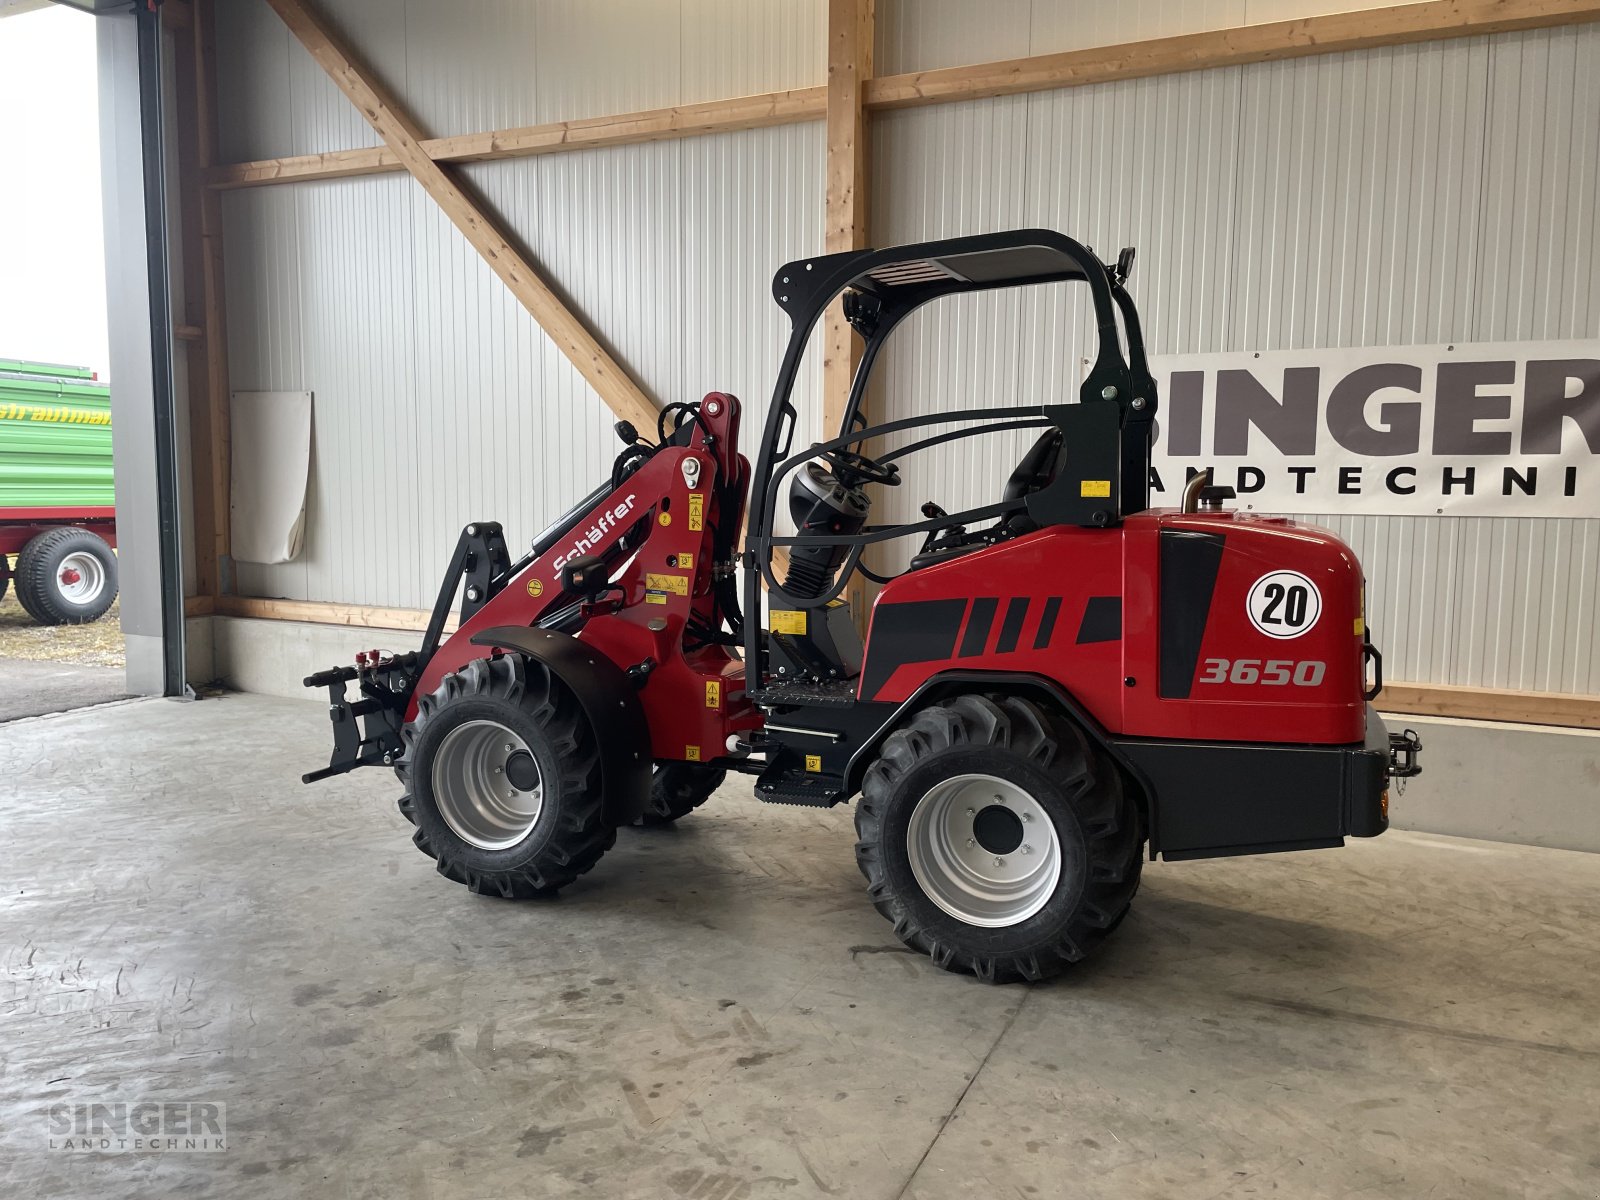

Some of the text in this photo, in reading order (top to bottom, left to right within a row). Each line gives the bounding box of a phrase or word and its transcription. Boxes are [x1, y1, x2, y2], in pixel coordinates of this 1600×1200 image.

[1150, 358, 1600, 457] INGER
[1261, 583, 1308, 627] 20
[1199, 658, 1327, 687] 3650
